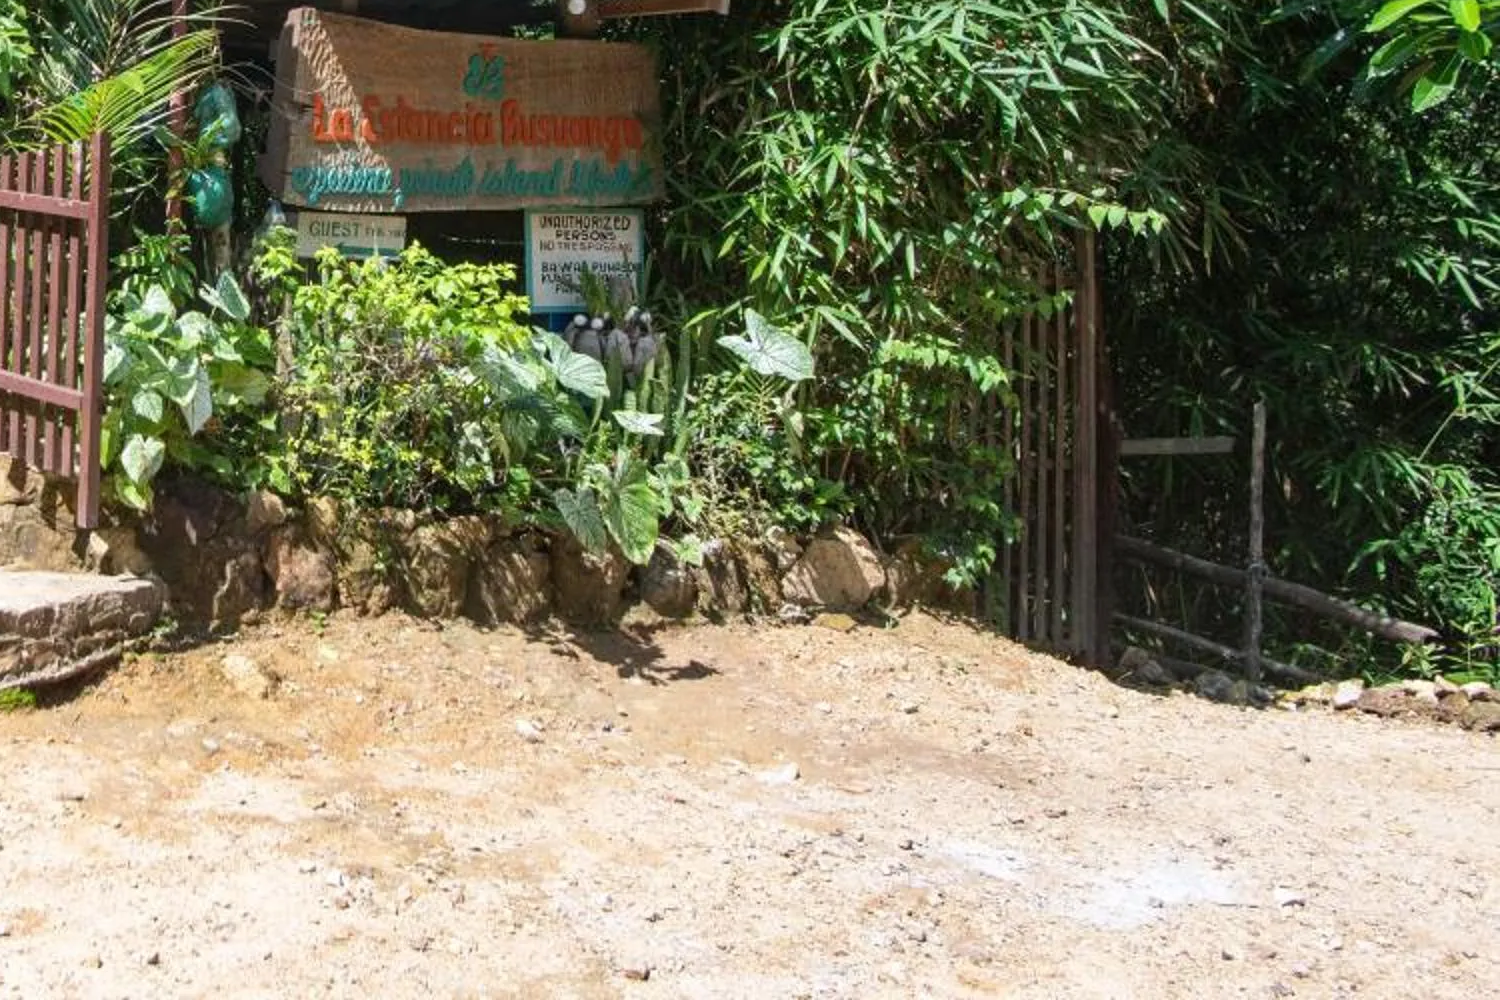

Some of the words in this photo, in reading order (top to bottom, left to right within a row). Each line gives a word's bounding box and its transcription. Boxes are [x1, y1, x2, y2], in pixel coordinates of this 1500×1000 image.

[312, 92, 353, 144] La
[357, 95, 496, 147] Estancia
[500, 99, 644, 165] Busuanga
[309, 220, 359, 238] GUEST
[540, 215, 631, 231] UNAUTHORIZED
[555, 229, 617, 241] PERSONS
[539, 240, 555, 251] NO
[541, 260, 587, 273] BAWA
